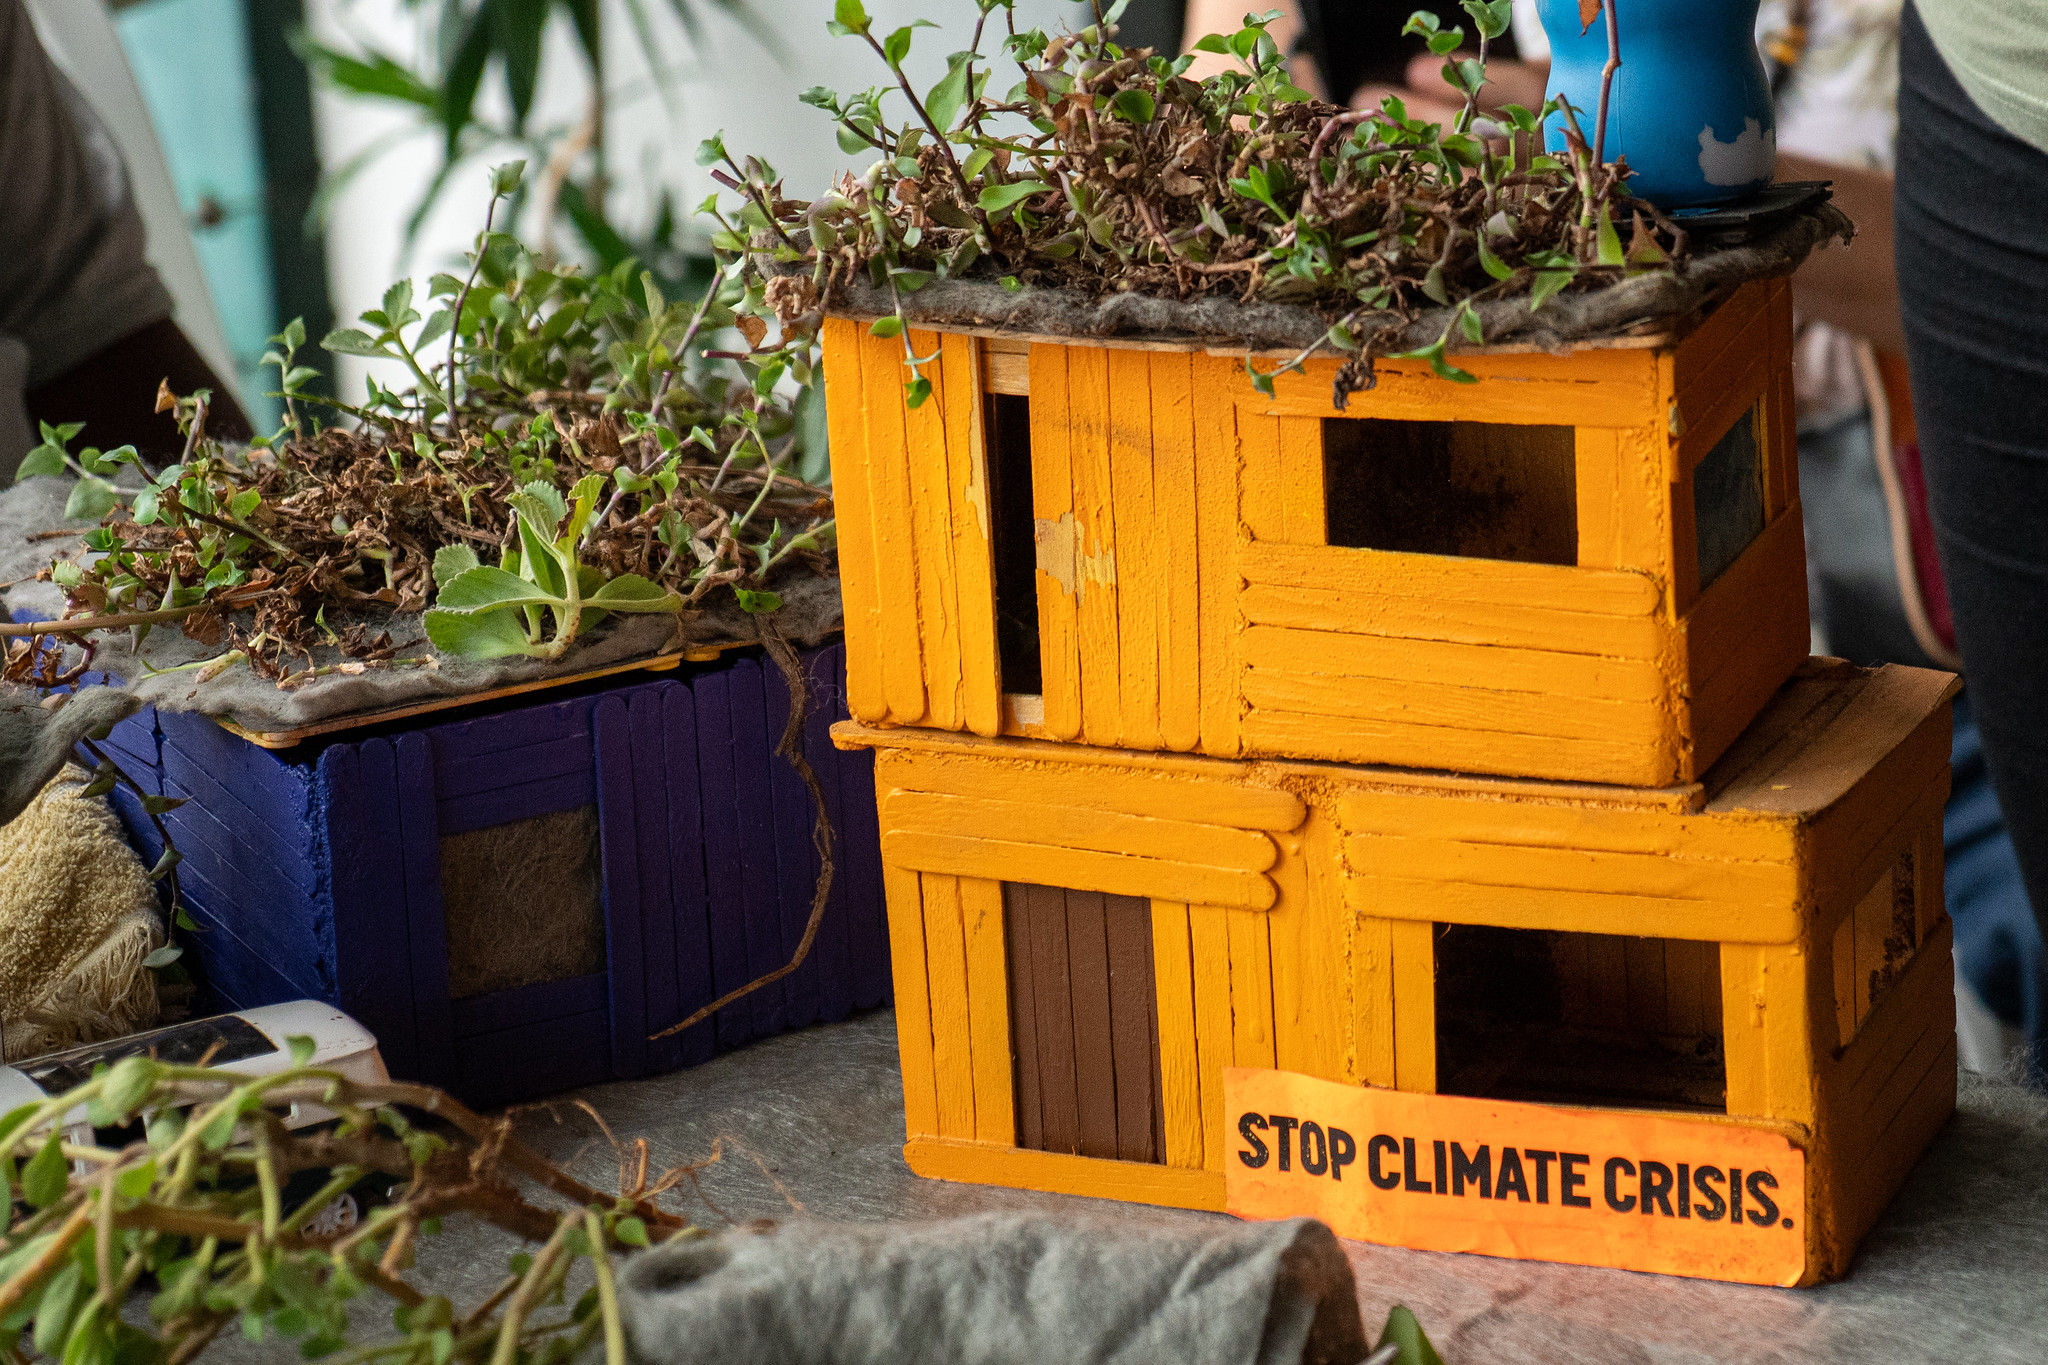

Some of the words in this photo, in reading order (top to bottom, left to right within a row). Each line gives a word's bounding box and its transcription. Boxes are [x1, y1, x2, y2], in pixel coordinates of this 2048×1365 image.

[1237, 1111, 1356, 1181] STOP
[1367, 1134, 1591, 1208] CLIMATE
[1604, 1156, 1794, 1230] CRISIS.
